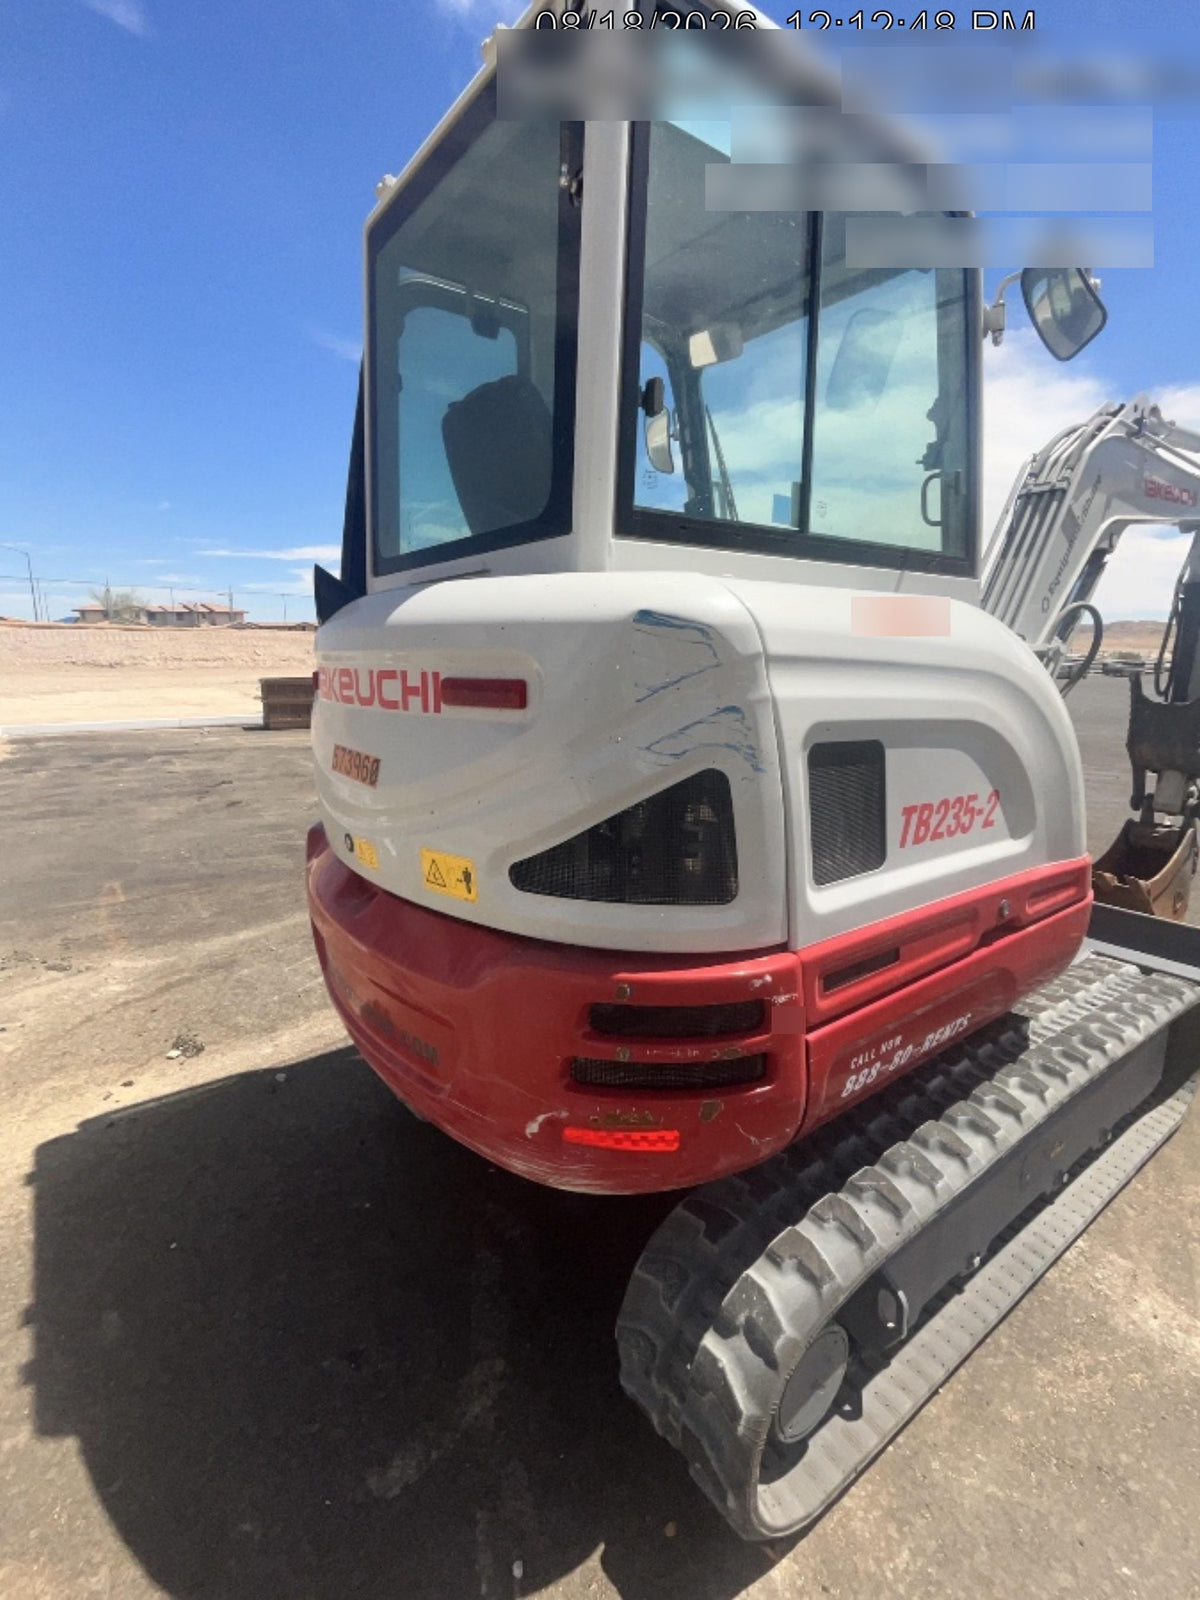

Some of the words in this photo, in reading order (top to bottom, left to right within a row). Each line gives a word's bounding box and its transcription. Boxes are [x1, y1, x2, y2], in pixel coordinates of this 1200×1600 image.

[899, 788, 1000, 849] TB235-2
[850, 1048, 876, 1070] CALL
[880, 1034, 902, 1055] NOW
